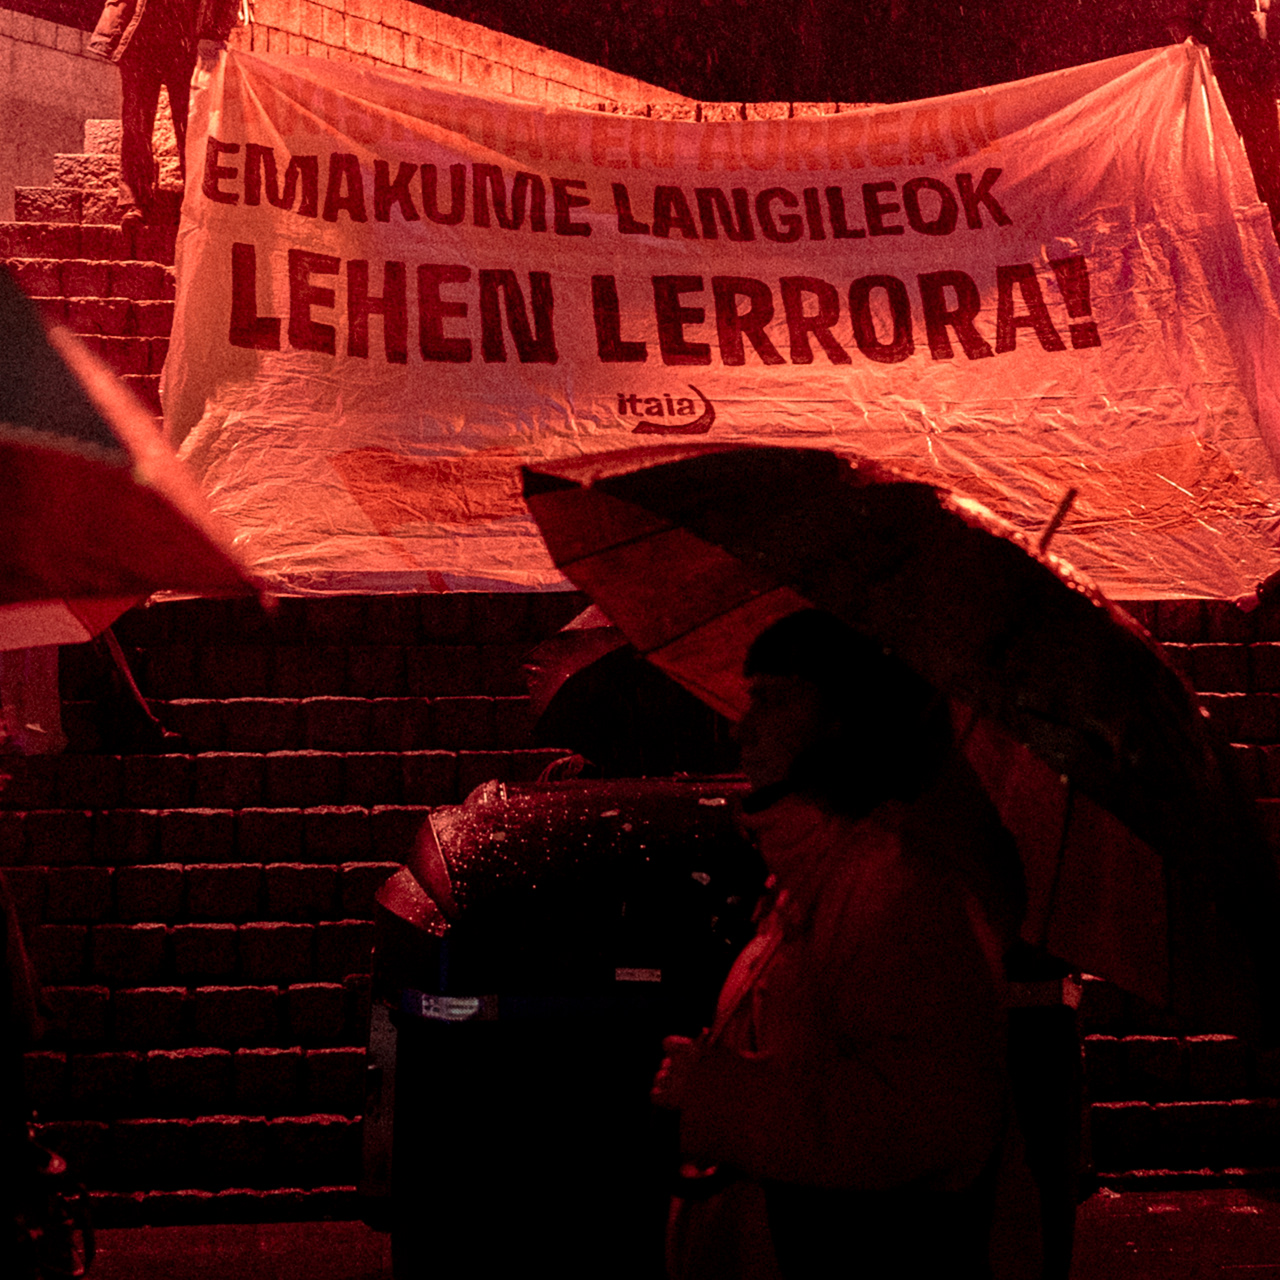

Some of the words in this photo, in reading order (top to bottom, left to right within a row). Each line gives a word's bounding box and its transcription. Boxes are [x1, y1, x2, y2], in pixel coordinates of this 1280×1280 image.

[696, 101, 1000, 171] AURREAN
[202, 136, 593, 237] EMAKUME
[611, 167, 1013, 243] LANGILEOK
[229, 242, 558, 364] LEHEN
[590, 255, 1101, 366] LERRORA!
[617, 393, 696, 417] itaia
